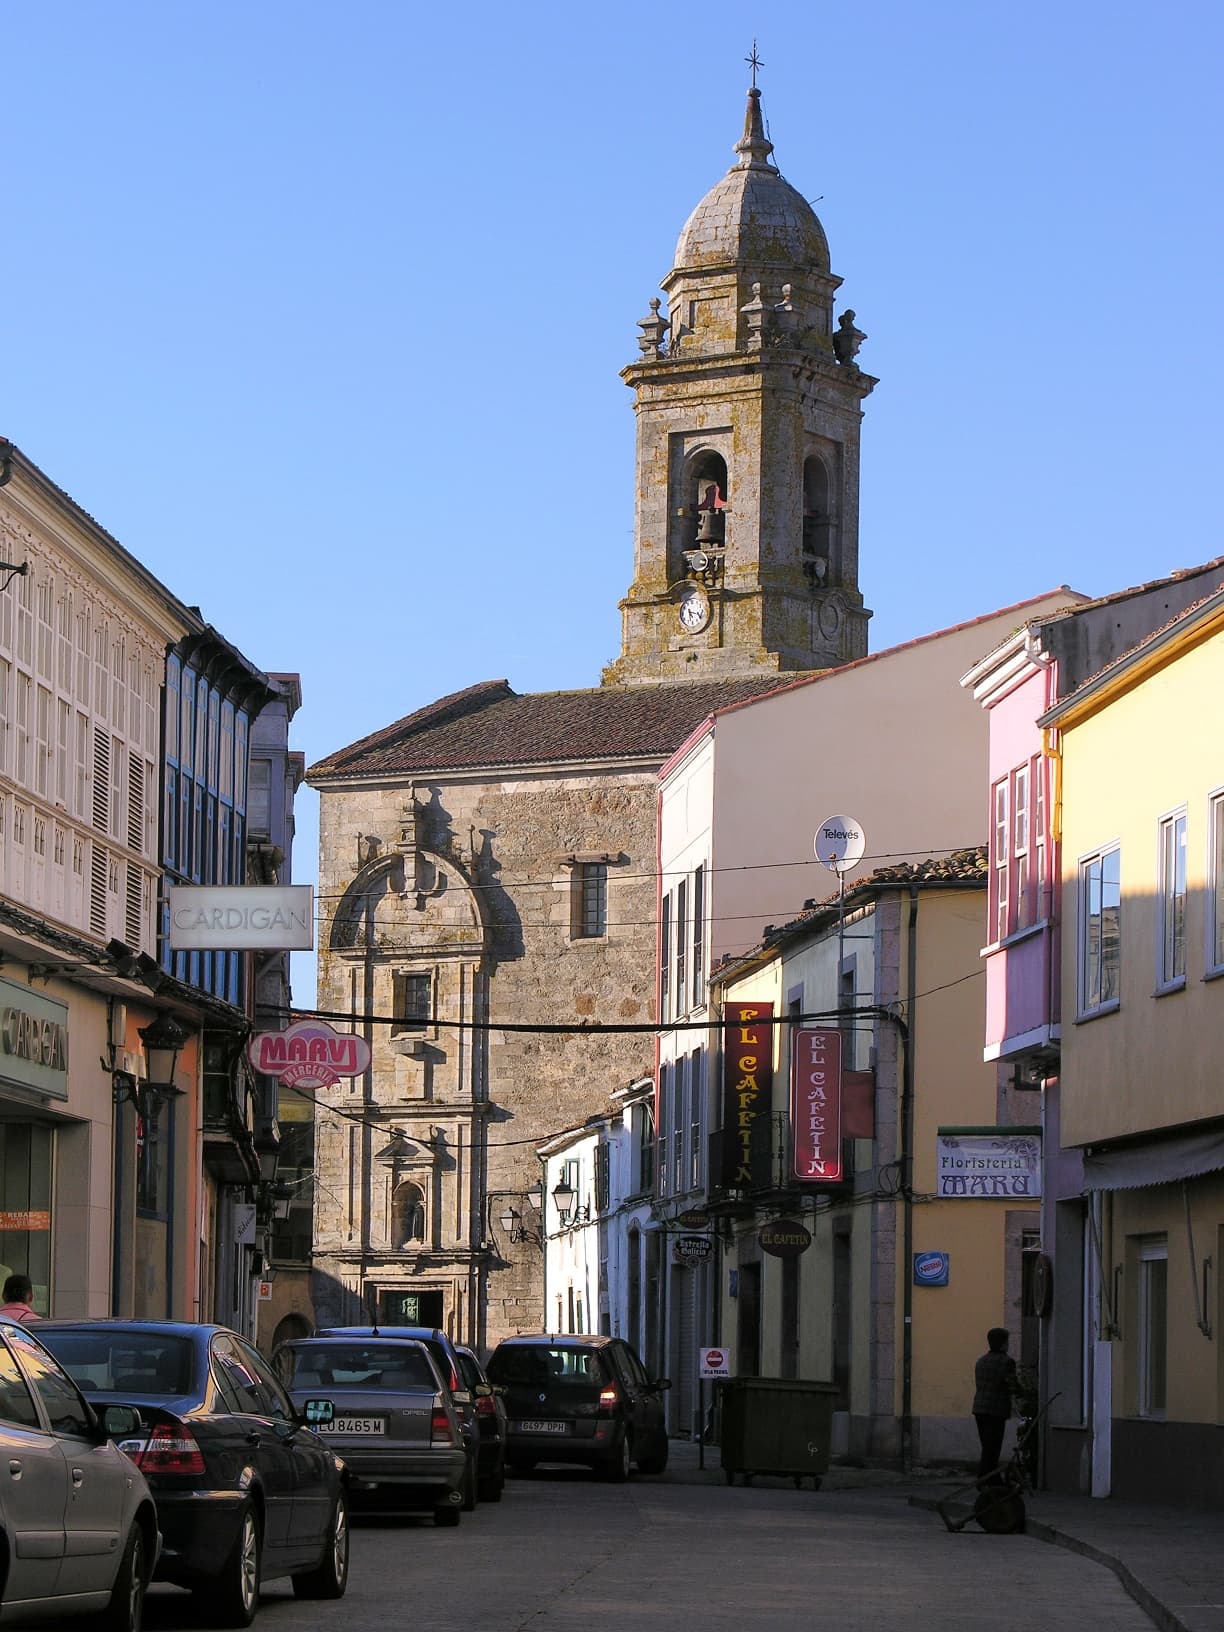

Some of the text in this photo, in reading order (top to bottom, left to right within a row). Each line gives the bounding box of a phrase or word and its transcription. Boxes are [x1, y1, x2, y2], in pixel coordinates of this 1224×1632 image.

[823, 829, 859, 839] Televés
[174, 907, 308, 930] CARDIGAN
[3, 1007, 65, 1072] CARDIGAN
[260, 1036, 357, 1073] MARVI
[736, 1009, 761, 1182] EL CAFETIN
[807, 1036, 828, 1174] EL CAFETIN
[941, 1175, 1030, 1195] MARU
[680, 1240, 709, 1249] Estrella
[762, 1233, 772, 1244] EL
[338, 1420, 370, 1433] 8465
[373, 1420, 381, 1433] M
